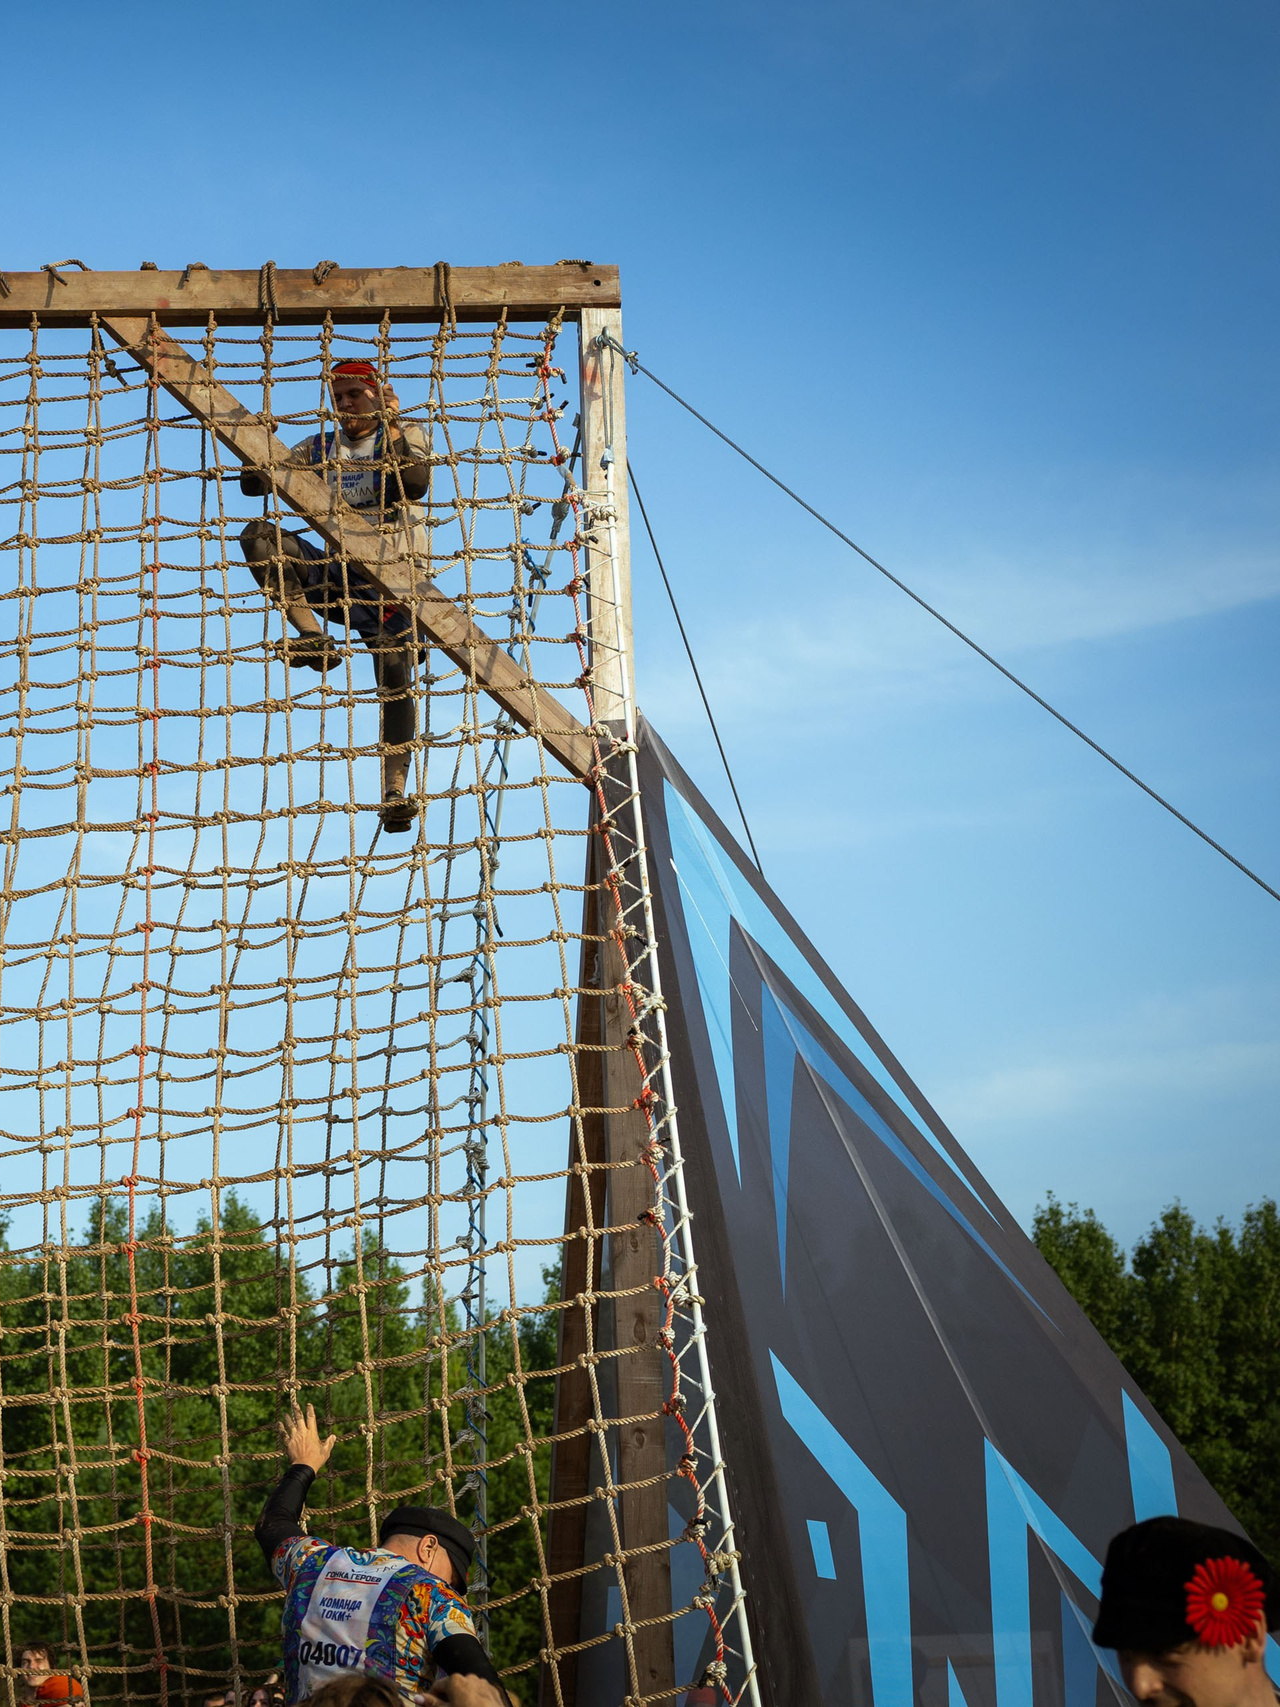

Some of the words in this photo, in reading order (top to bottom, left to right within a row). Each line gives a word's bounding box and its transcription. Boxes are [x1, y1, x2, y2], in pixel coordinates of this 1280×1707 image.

[333, 473, 364, 482] КМАНДА
[326, 1571, 349, 1579] ГОНКА
[350, 1573, 382, 1583] ГЕРОЕВ
[319, 1597, 362, 1612] КОМАНДА
[321, 1609, 352, 1622] 10КМ+
